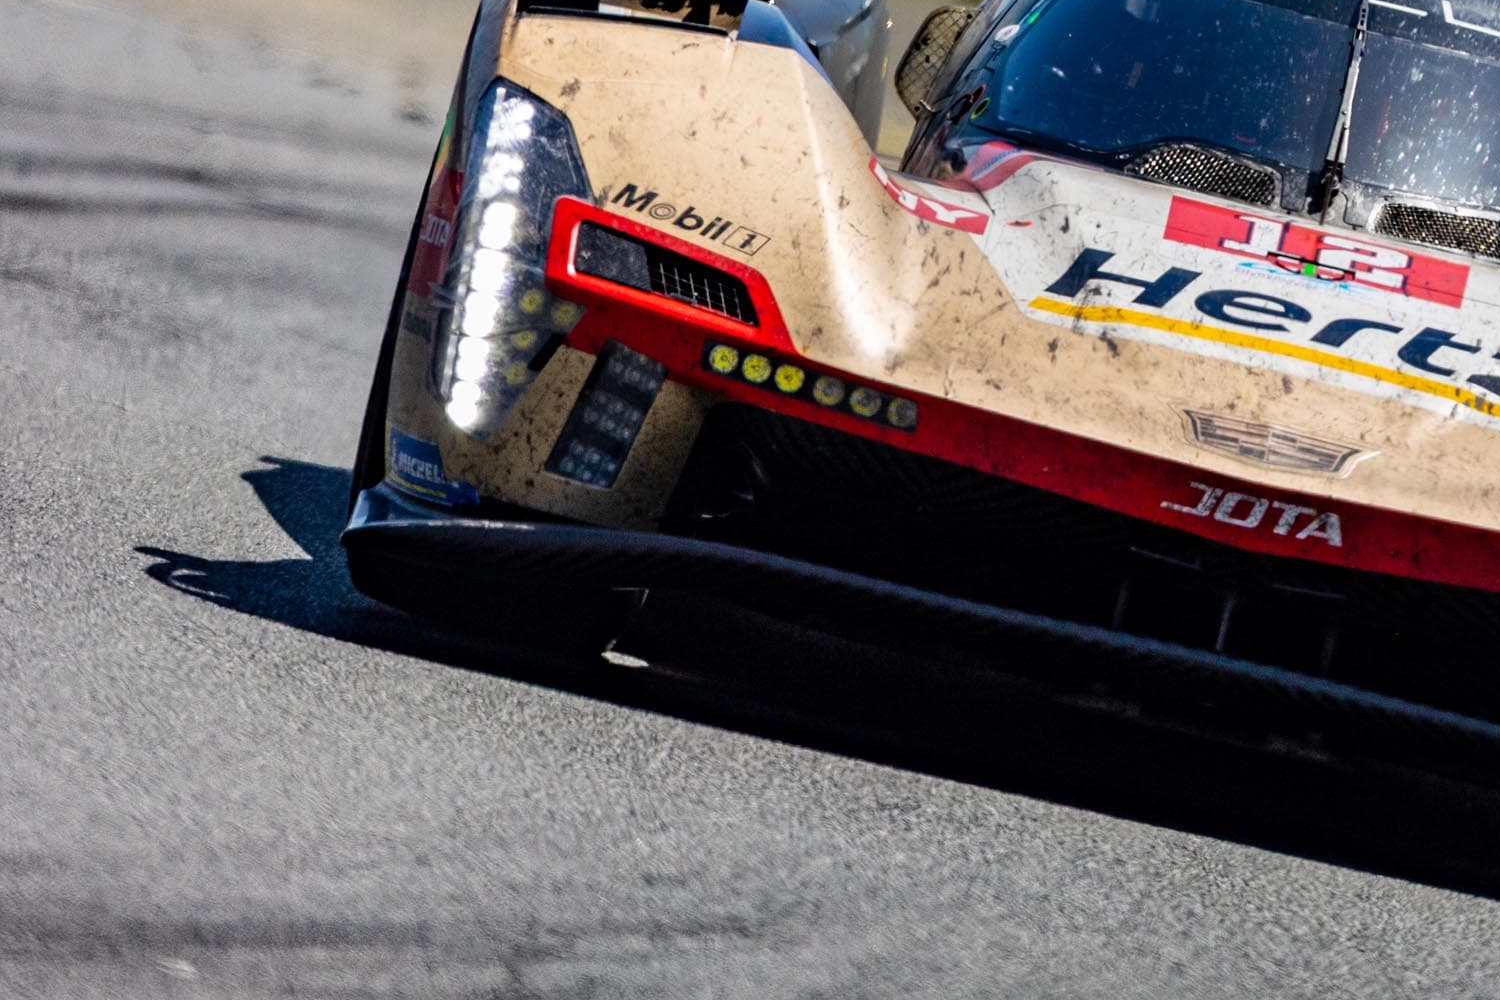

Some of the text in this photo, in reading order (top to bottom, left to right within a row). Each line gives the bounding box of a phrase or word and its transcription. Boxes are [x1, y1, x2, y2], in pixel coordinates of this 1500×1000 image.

[610, 183, 734, 241] Mobil
[1218, 213, 1413, 296] 12
[1159, 480, 1344, 548] JOTA
